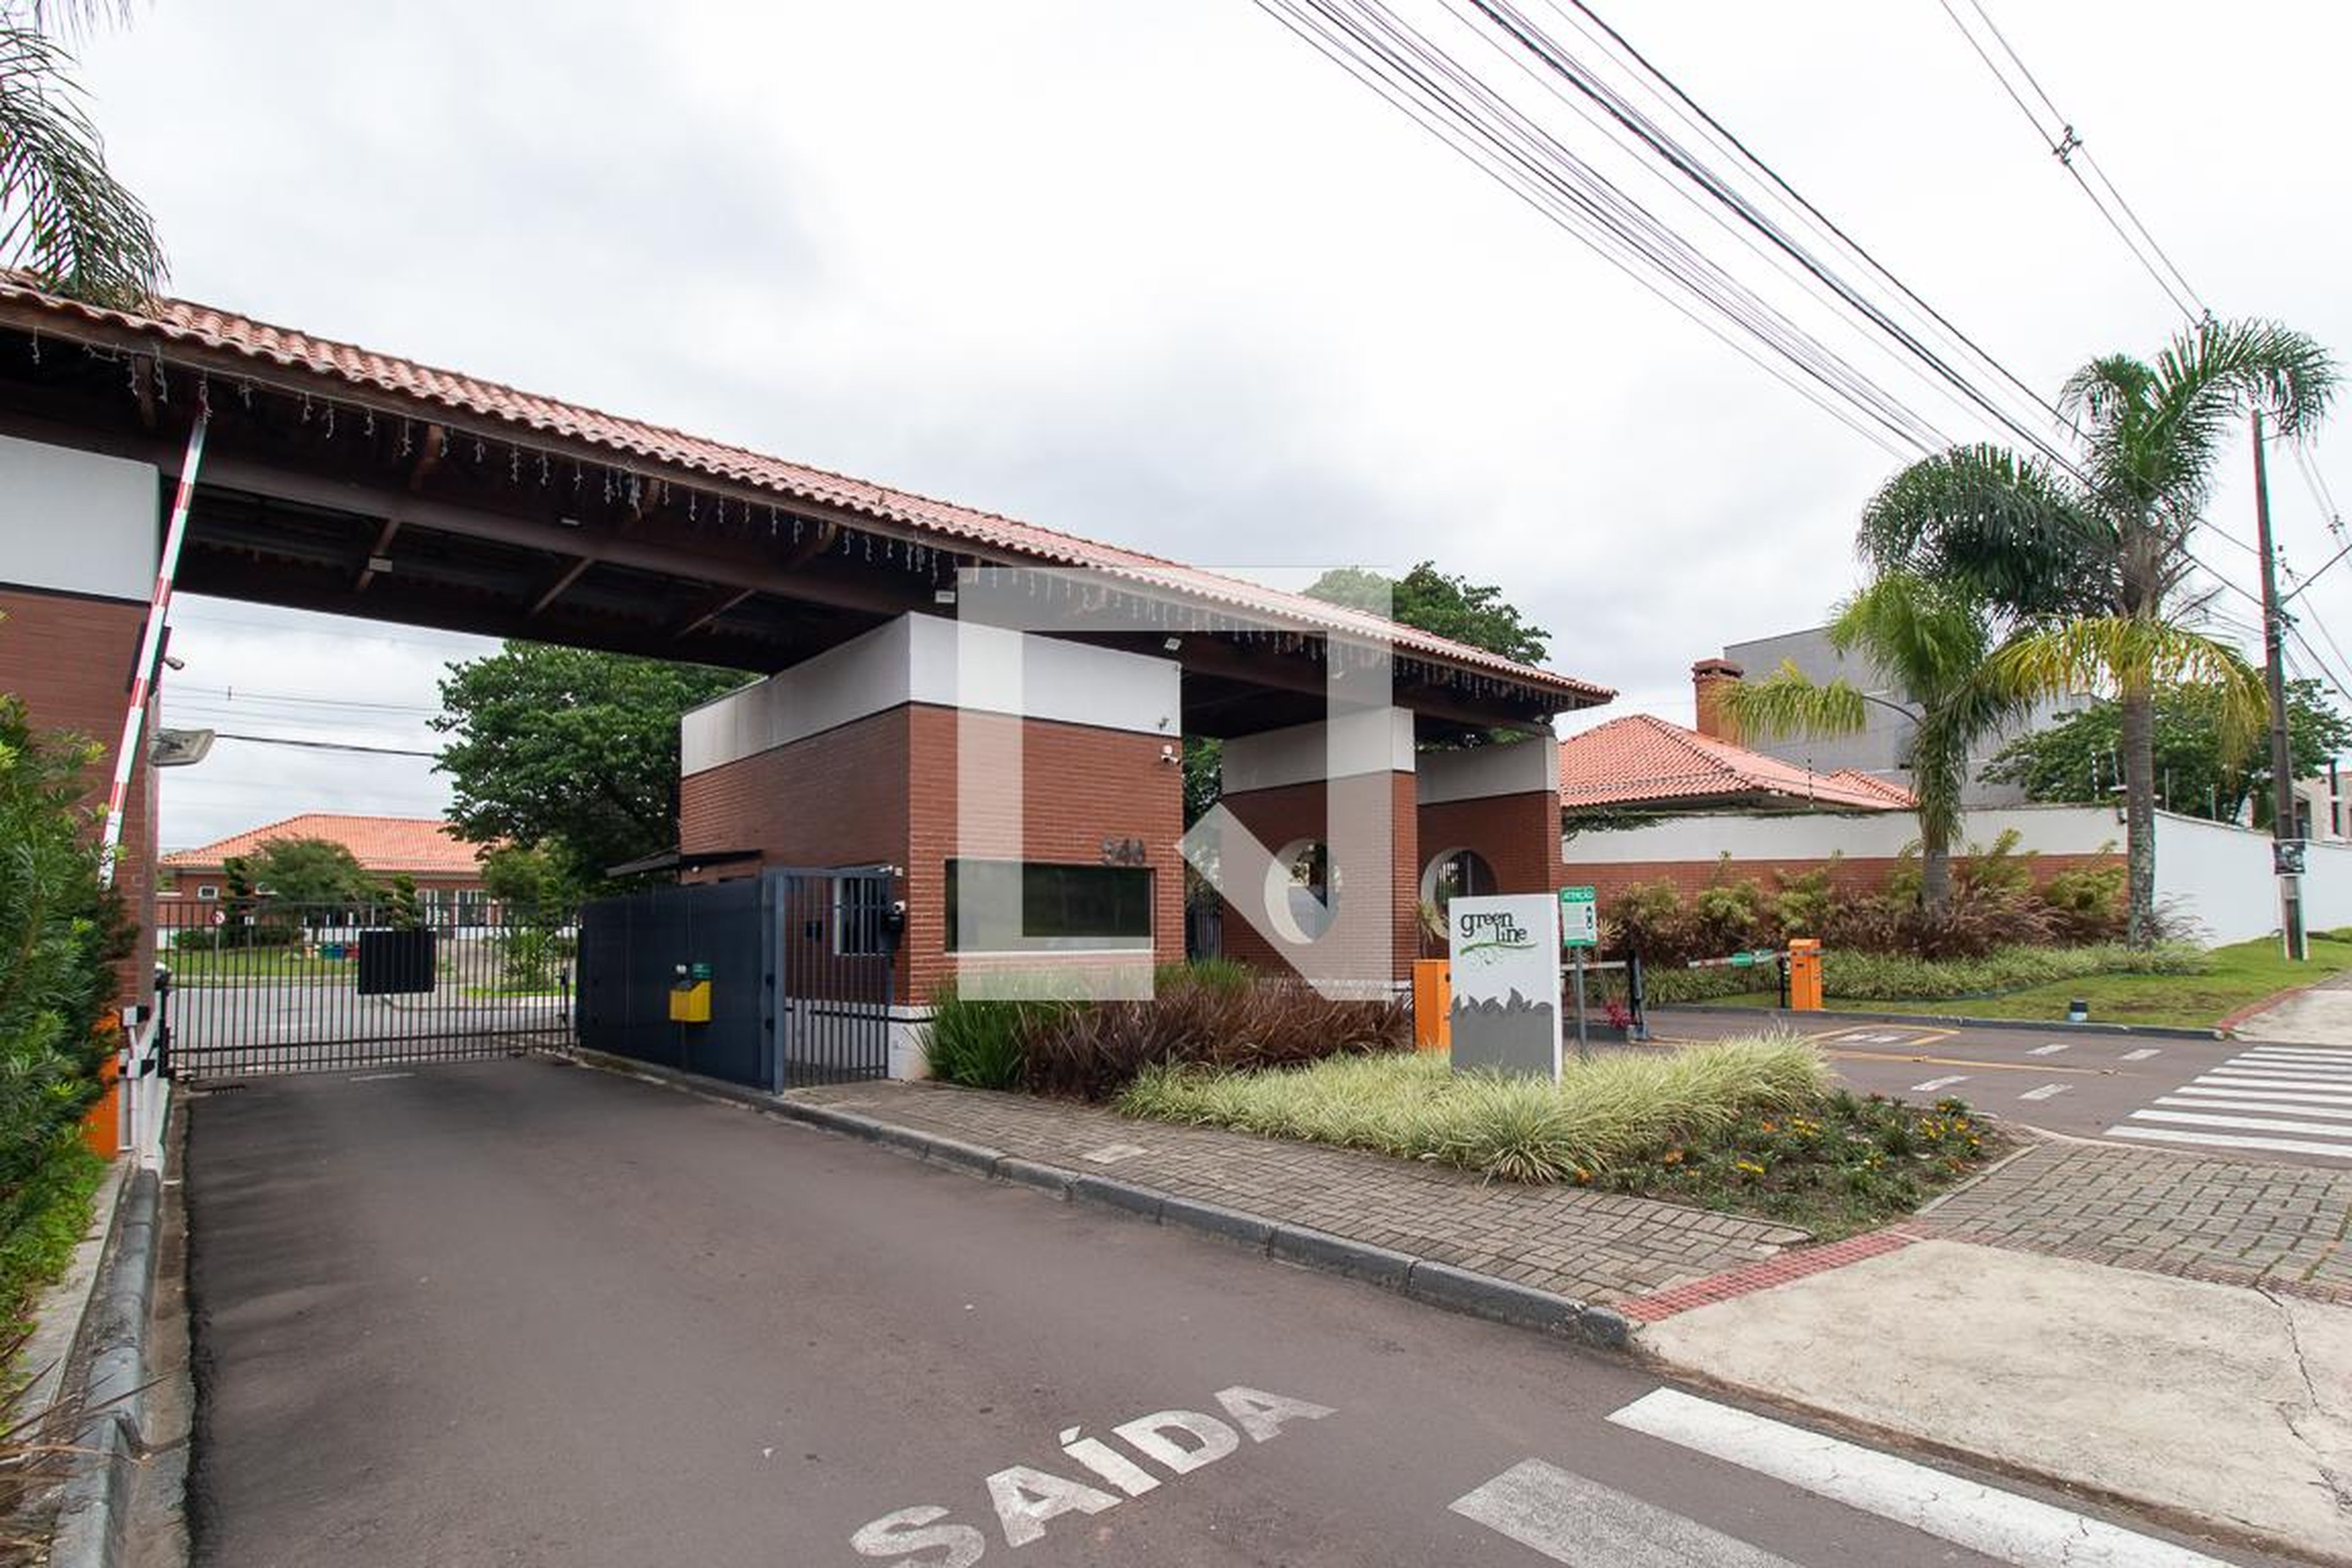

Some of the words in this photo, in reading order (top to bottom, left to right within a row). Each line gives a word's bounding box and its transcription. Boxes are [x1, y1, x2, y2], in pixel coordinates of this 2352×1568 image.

[1460, 912, 1513, 938] green
[1494, 922, 1527, 943] line
[850, 1385, 1340, 1568] SAÍDA
